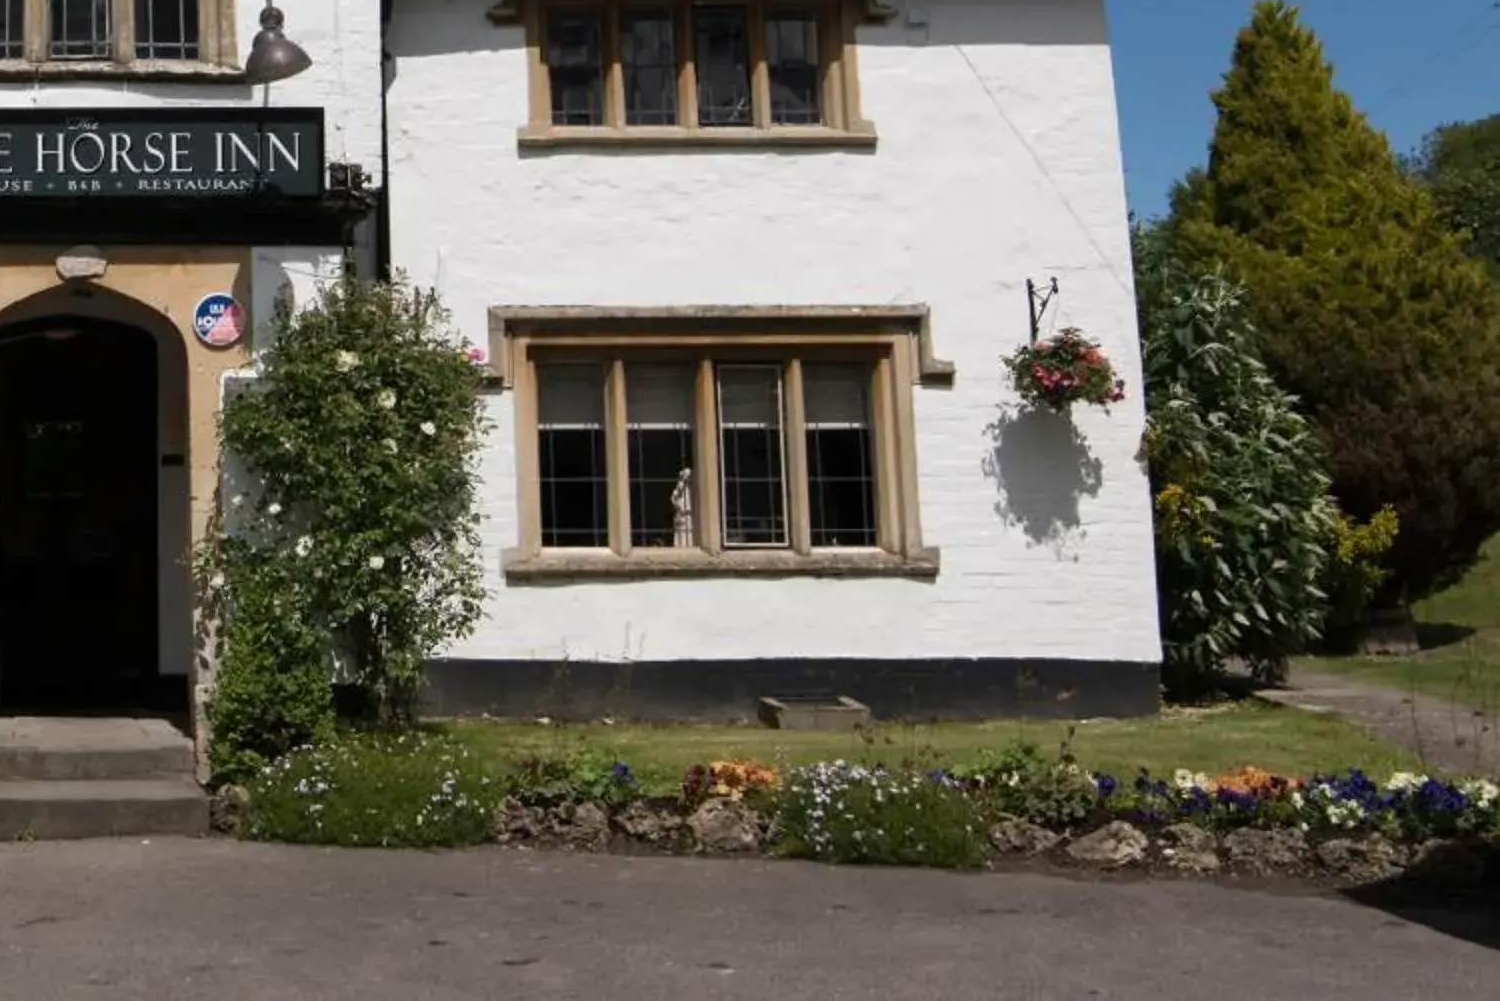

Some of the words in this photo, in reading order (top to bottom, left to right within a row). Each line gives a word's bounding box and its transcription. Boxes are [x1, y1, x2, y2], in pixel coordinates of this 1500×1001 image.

[35, 131, 194, 174] HORSE
[214, 132, 301, 173] INN
[67, 178, 101, 192] B&B
[137, 177, 269, 192] RESTAURANT
